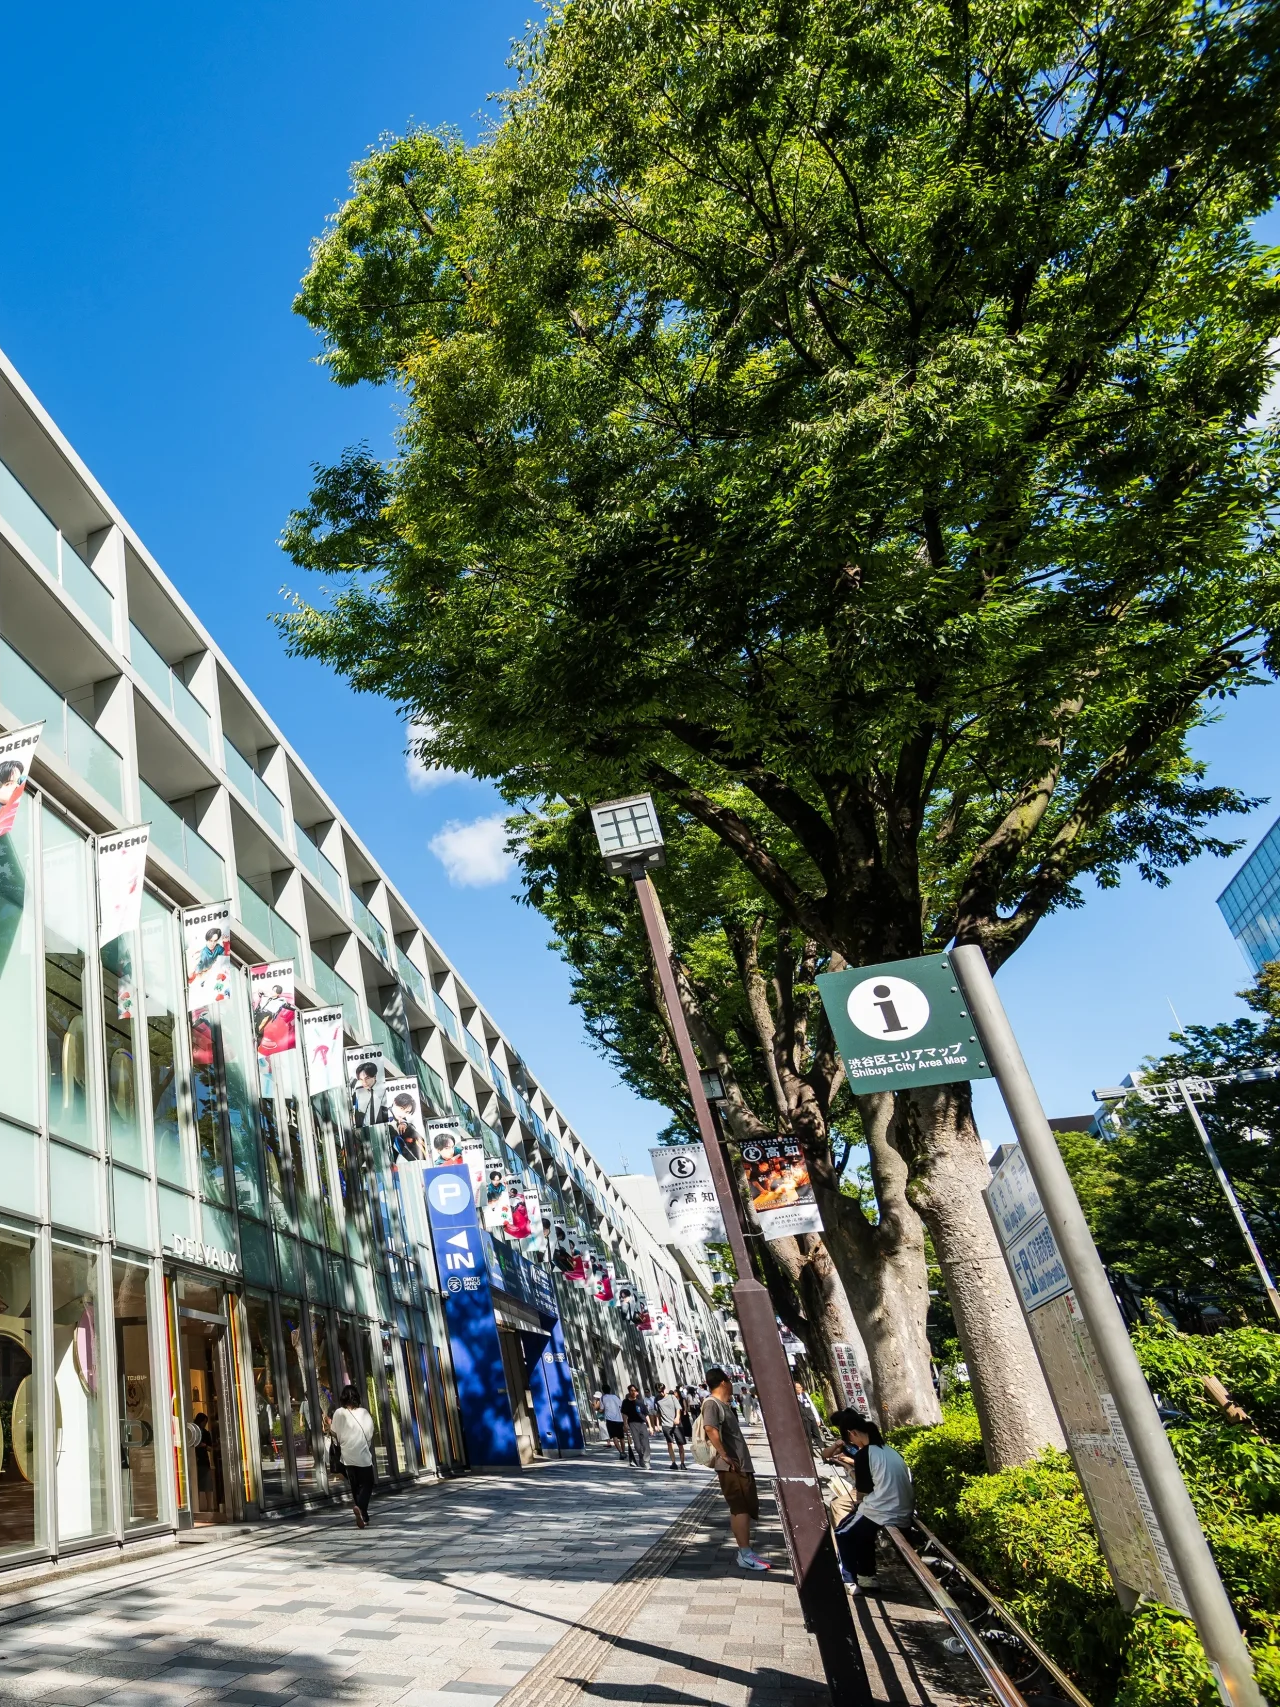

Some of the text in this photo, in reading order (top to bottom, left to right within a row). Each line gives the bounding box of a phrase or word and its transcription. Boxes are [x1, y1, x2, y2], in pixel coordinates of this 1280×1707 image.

[99, 834, 148, 854] MOREMO
[185, 909, 229, 926] MOREMO
[251, 967, 293, 981] MOREMO
[304, 1012, 342, 1025] MOREMO
[347, 1050, 383, 1062] MOREMO
[848, 1042, 962, 1070] 渋谷区エリアマップ
[851, 1055, 968, 1078] Shibuya City Area Map
[428, 1121, 459, 1131] MOREMO
[764, 1145, 800, 1158] 高知
[438, 1183, 461, 1206] P
[684, 1191, 715, 1204] 高知
[172, 1233, 240, 1273] DELVAUX
[445, 1252, 475, 1269] IN
[844, 1346, 868, 1412] 歩道は歩行者が優先
